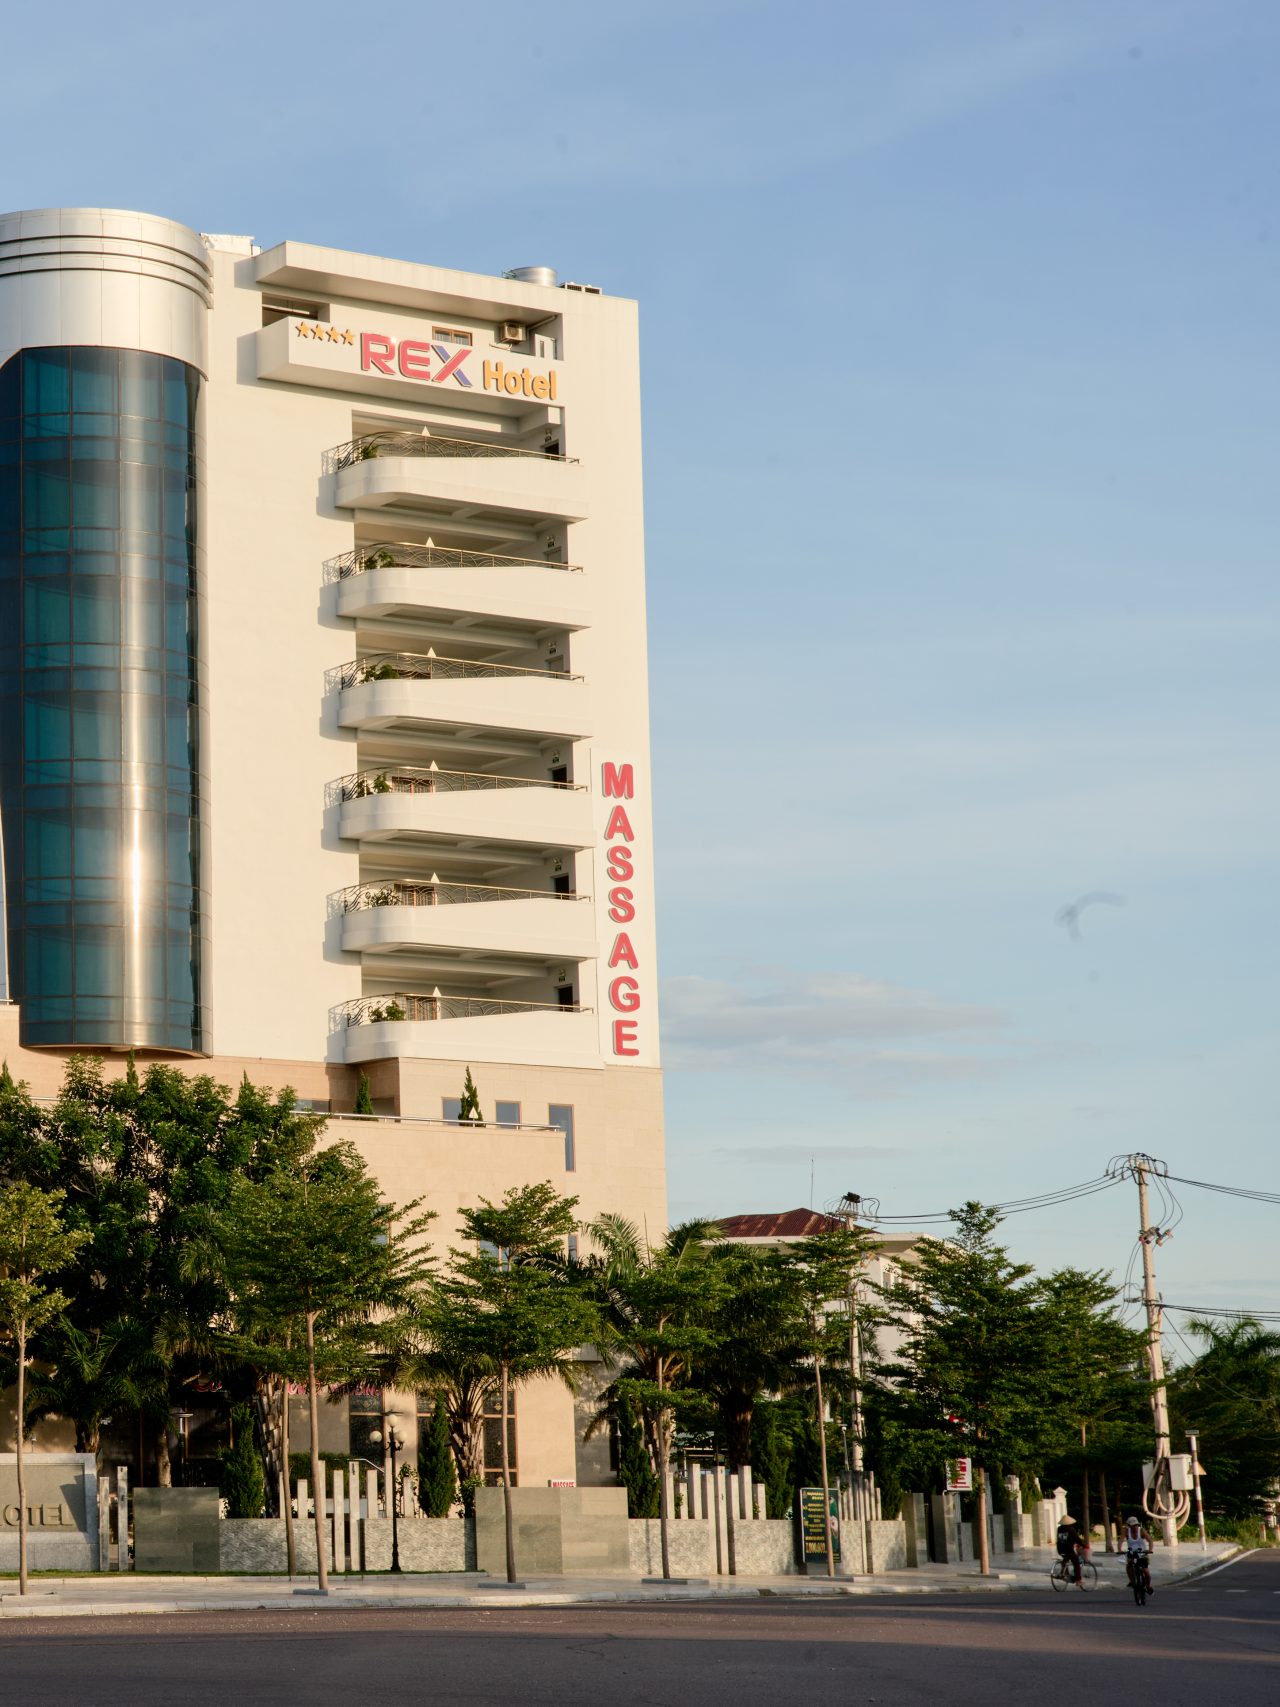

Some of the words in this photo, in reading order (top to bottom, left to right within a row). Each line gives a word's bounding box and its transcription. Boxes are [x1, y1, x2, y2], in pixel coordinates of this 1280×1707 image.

[361, 332, 472, 387] REX
[483, 359, 557, 400] Hotel
[601, 761, 641, 1057] MASSAGE
